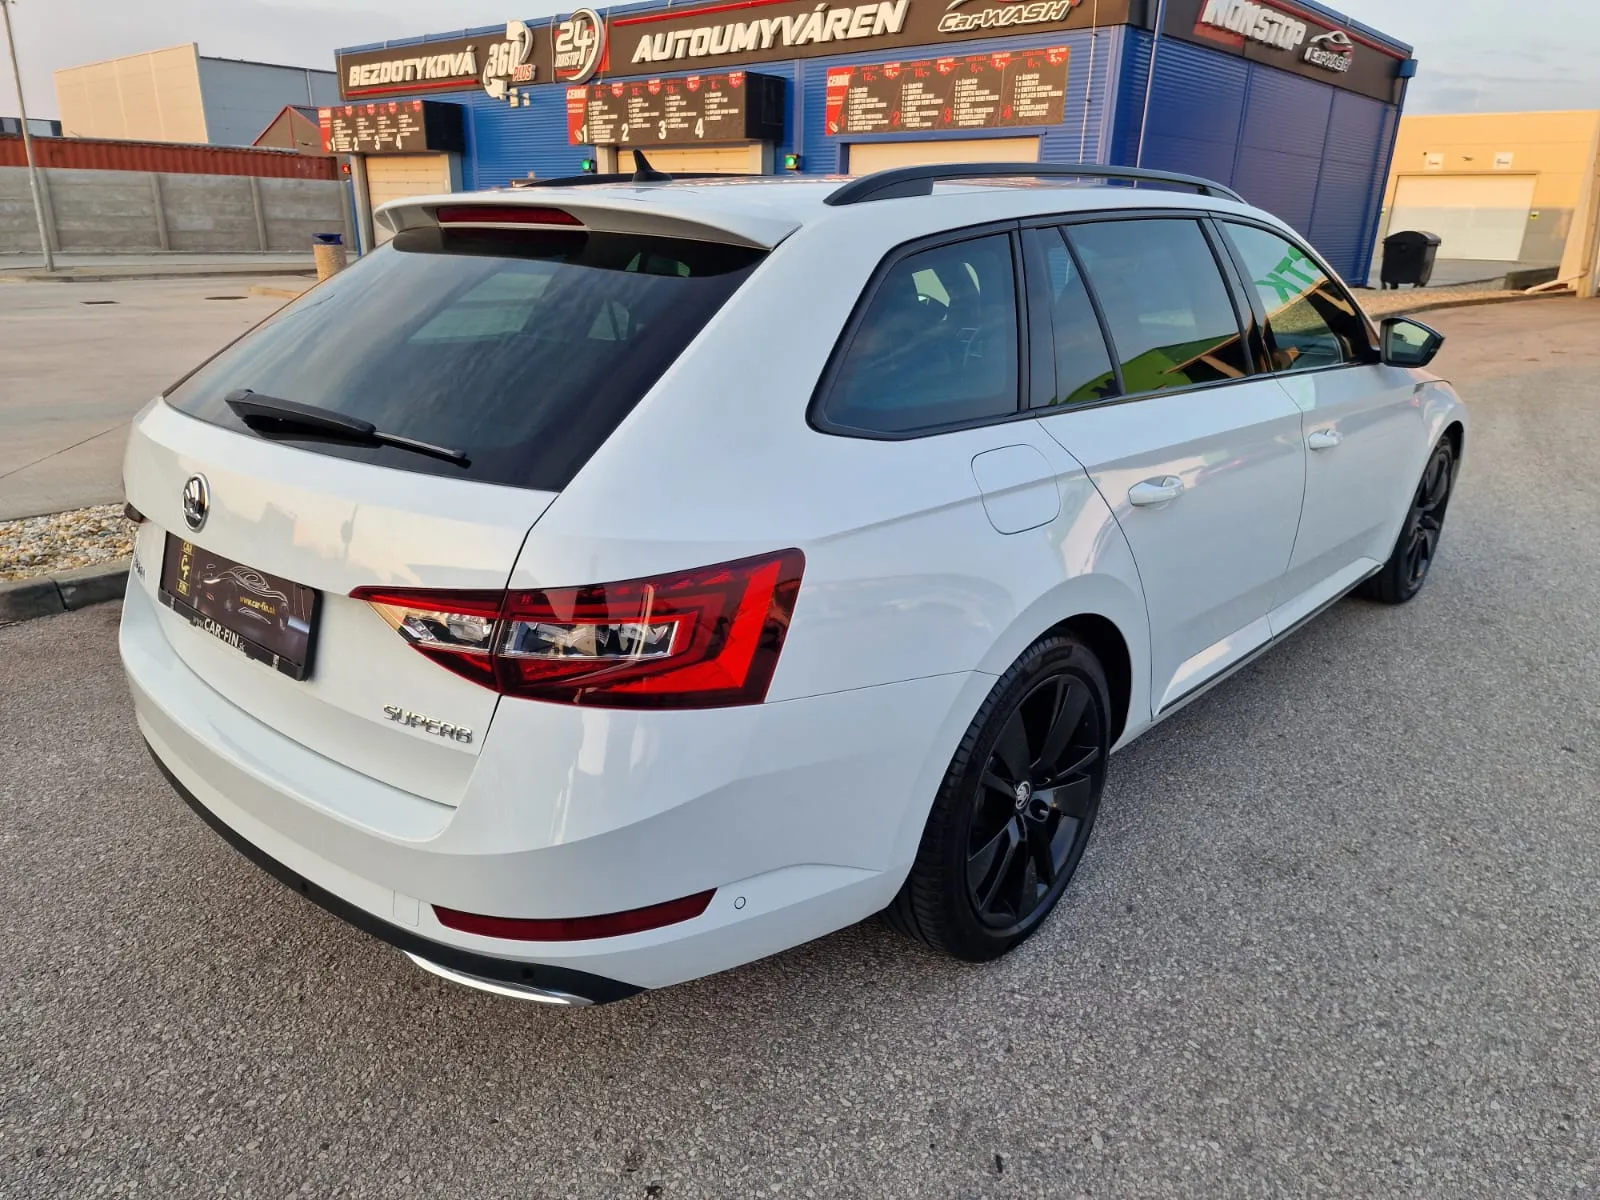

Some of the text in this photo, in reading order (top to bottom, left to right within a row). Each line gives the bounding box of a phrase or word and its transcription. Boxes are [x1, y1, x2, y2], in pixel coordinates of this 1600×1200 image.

[556, 20, 592, 65] 24
[632, 0, 910, 64] AUTOUMYVÁREN
[1201, 0, 1307, 50] NONSTOP
[349, 45, 479, 87] BEZDOTYKOVÁ
[486, 41, 520, 78] 360
[512, 64, 535, 81] PLUS
[581, 124, 588, 143] 1
[621, 123, 629, 142] 2
[658, 120, 667, 140] 3
[695, 118, 704, 139] 4
[383, 704, 473, 745] SUPERB
